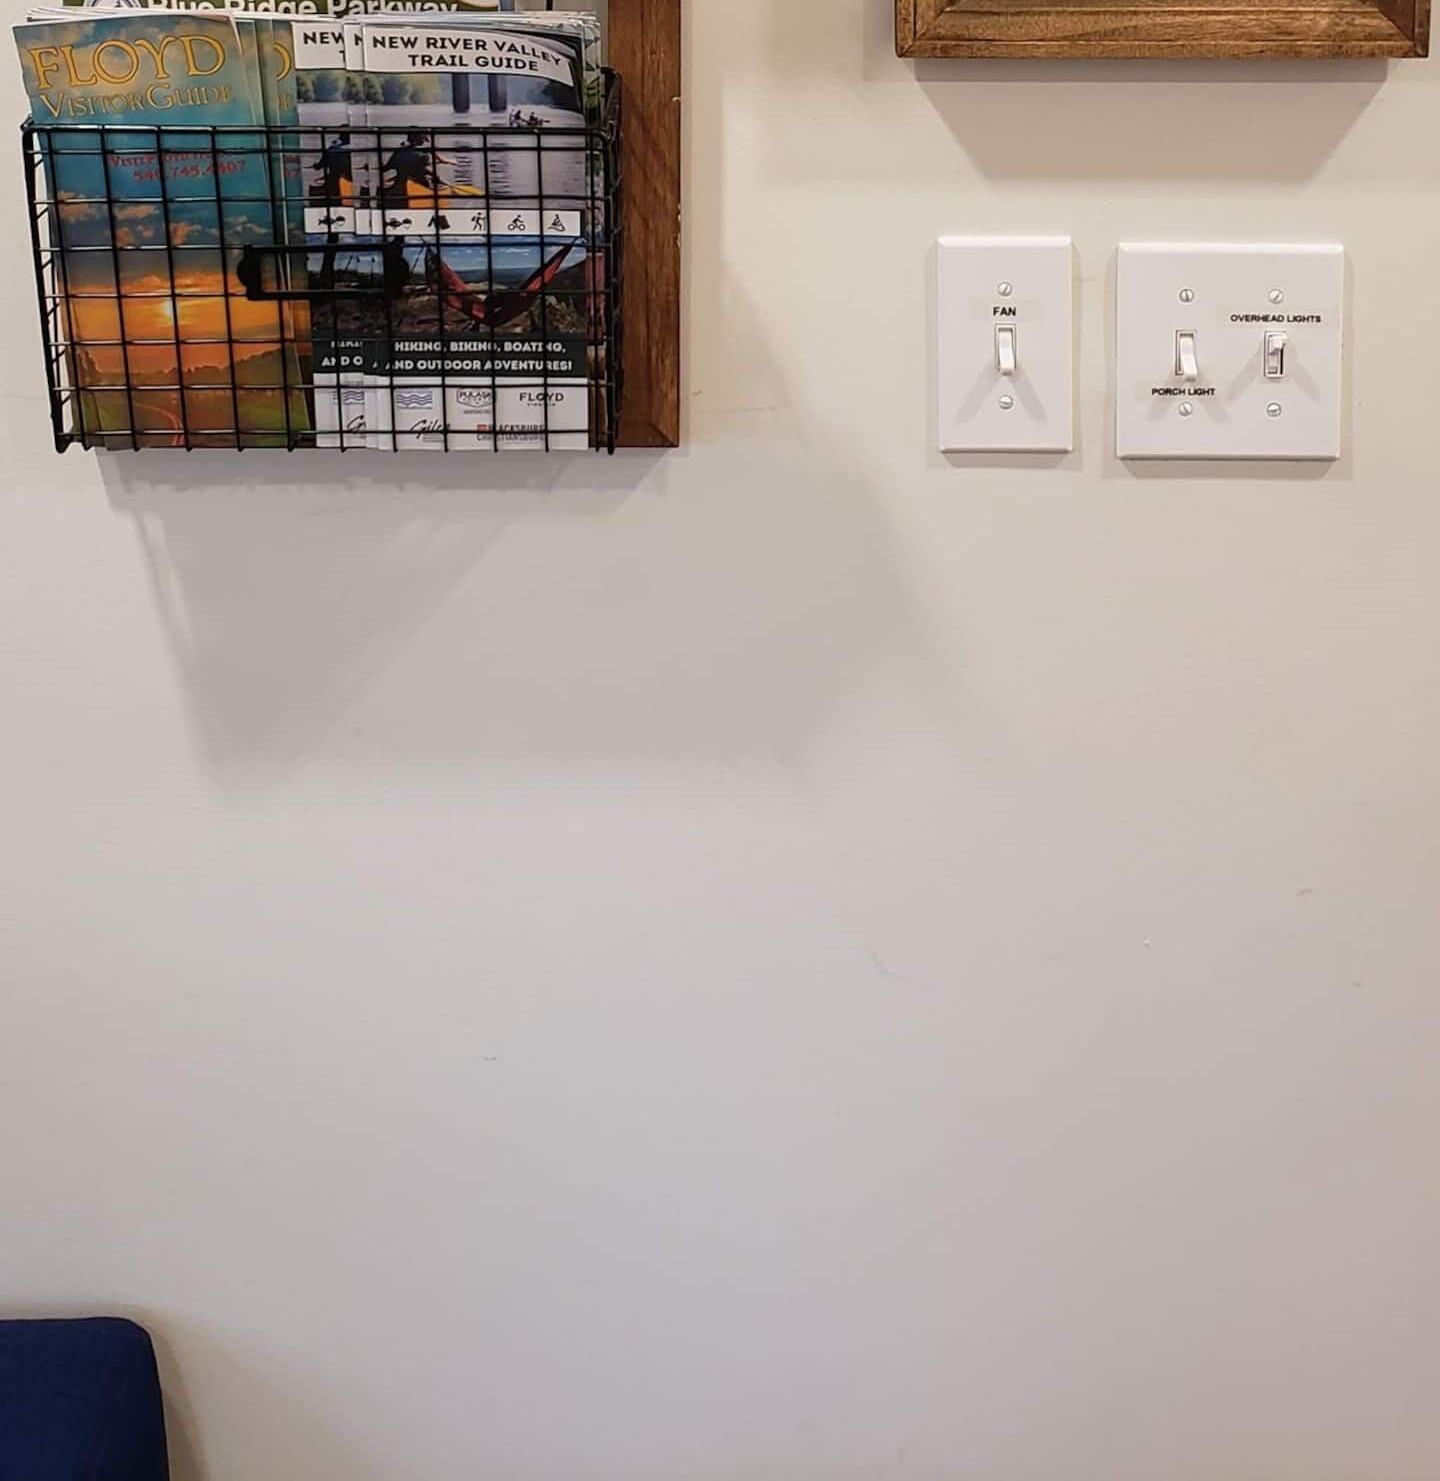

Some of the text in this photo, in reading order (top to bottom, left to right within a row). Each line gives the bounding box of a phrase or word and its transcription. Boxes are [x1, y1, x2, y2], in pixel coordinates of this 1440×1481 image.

[372, 36, 418, 50] NEW
[426, 37, 488, 52] RIVER
[494, 40, 562, 66] VALLEY
[28, 34, 226, 90] FLOYD
[408, 54, 539, 72] TRAIL GUIDE
[40, 84, 232, 118] VISITOR GUIDE
[993, 307, 1016, 316] FAN
[1230, 314, 1322, 324] OVERHEAD LIGHTS
[395, 342, 446, 352] HIKING,
[417, 360, 481, 370] OUTDOOR
[484, 360, 572, 371] ADVENTURES!
[1152, 387, 1216, 396] PORCH LIGHT
[519, 392, 564, 403] FLOYD
